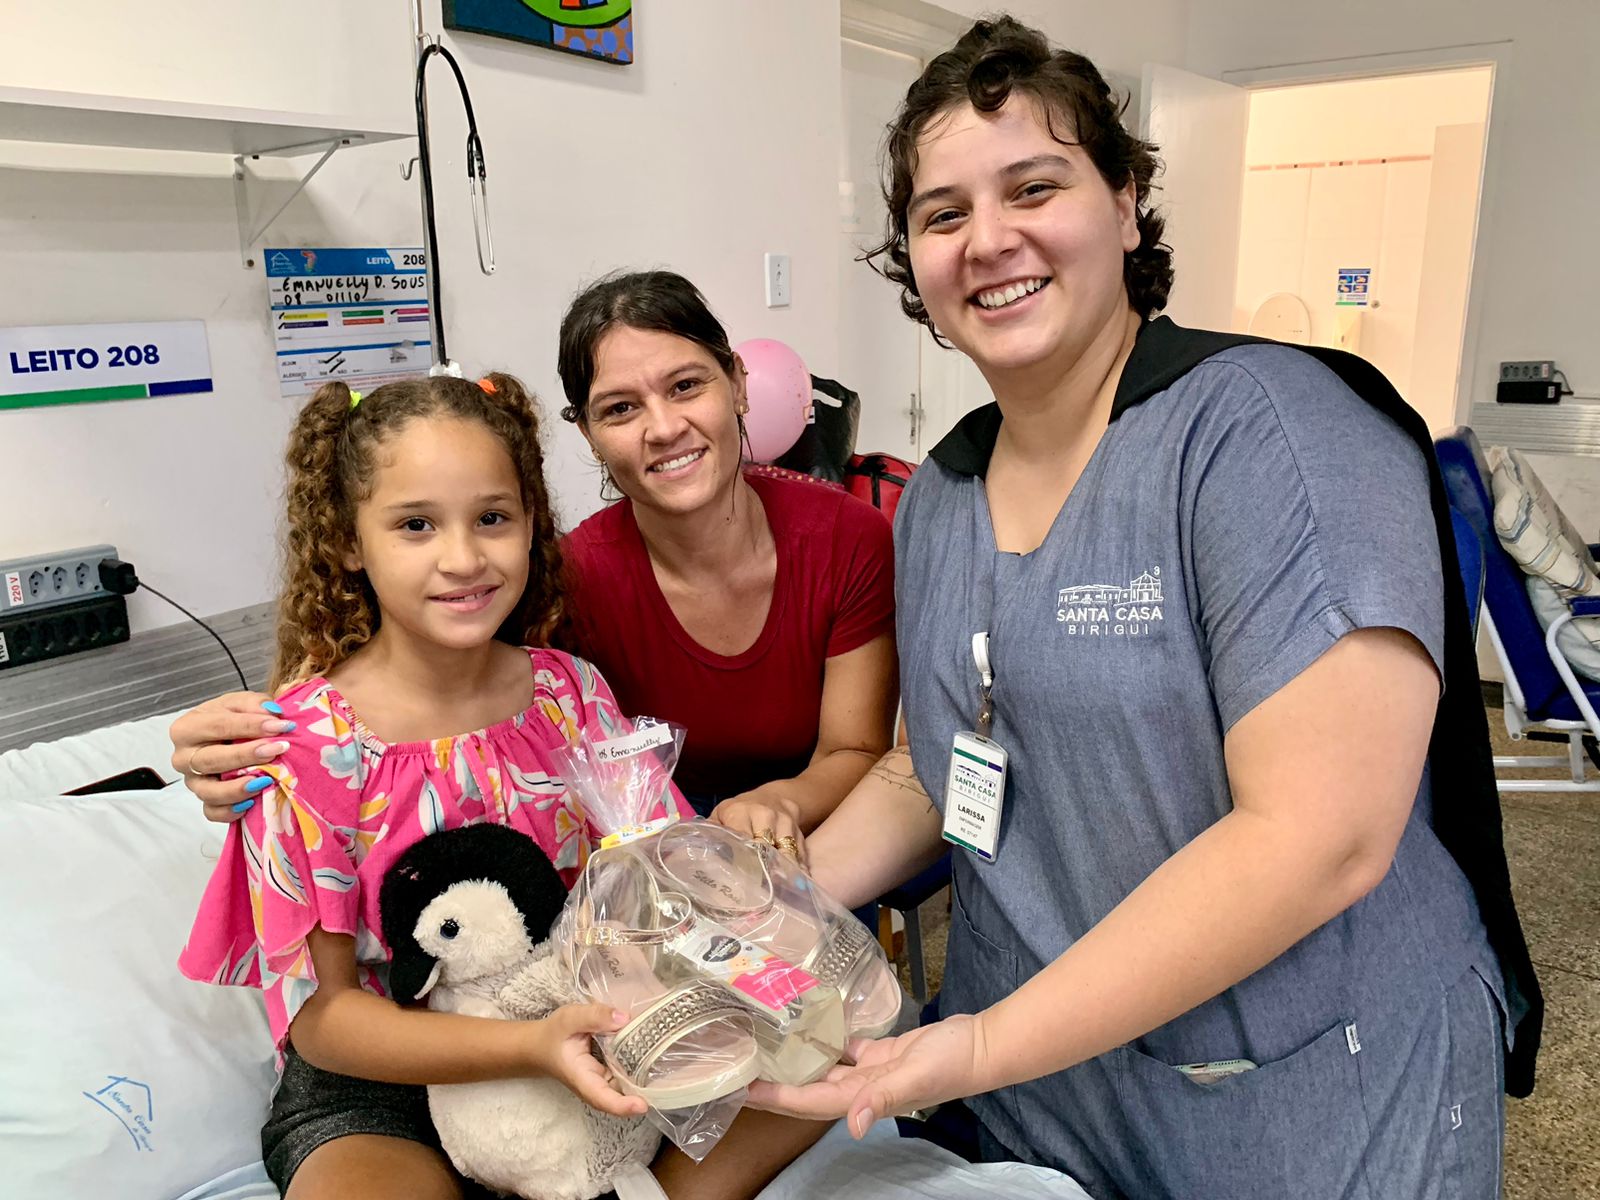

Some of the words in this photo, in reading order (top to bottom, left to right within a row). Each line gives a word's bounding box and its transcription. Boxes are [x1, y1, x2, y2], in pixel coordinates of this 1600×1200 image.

[366, 256, 391, 265] LEITO
[403, 254, 427, 266] 208
[9, 348, 100, 374] LEITO
[107, 344, 160, 367] 208
[11, 584, 22, 602] 220
[1056, 607, 1110, 622] SANTA
[1115, 606, 1164, 621] CASA
[1068, 623, 1149, 636] BIRIGUI
[954, 774, 976, 790] SANTA
[978, 785, 996, 799] CASA
[957, 803, 985, 823] LARISSA
